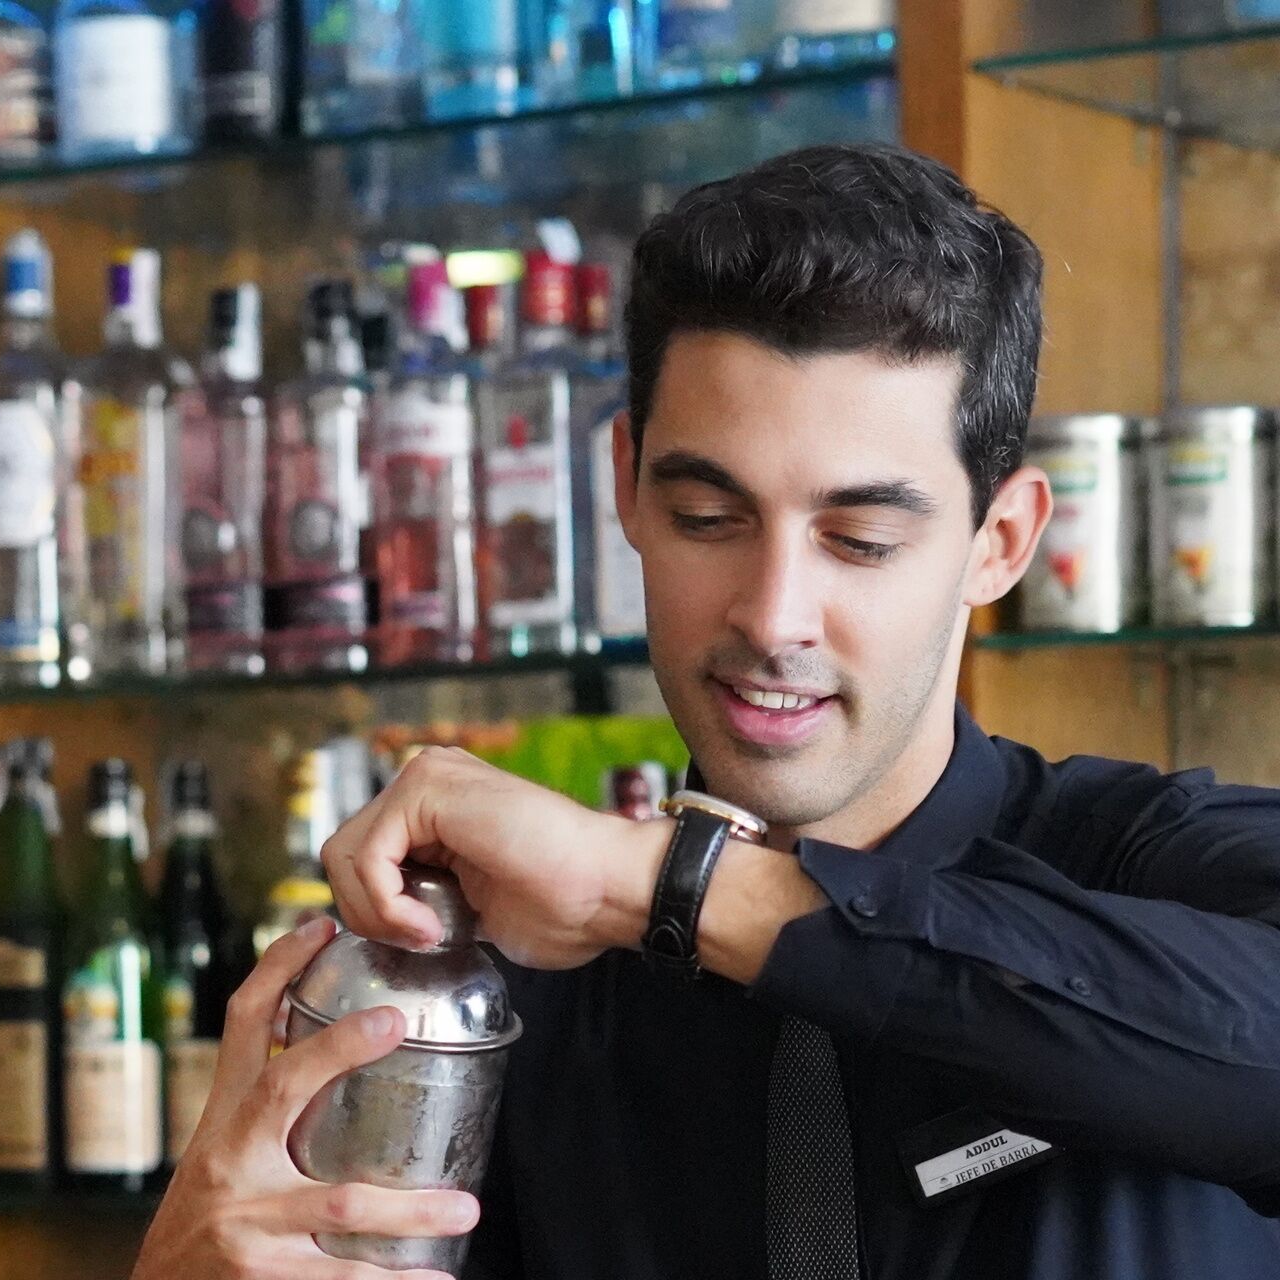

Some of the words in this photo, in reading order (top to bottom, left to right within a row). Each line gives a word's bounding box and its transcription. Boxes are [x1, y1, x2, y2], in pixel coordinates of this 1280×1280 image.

[955, 1166, 981, 1185] JEFE
[981, 1159, 999, 1174] DE
[1000, 1144, 1038, 1166] BARRA
